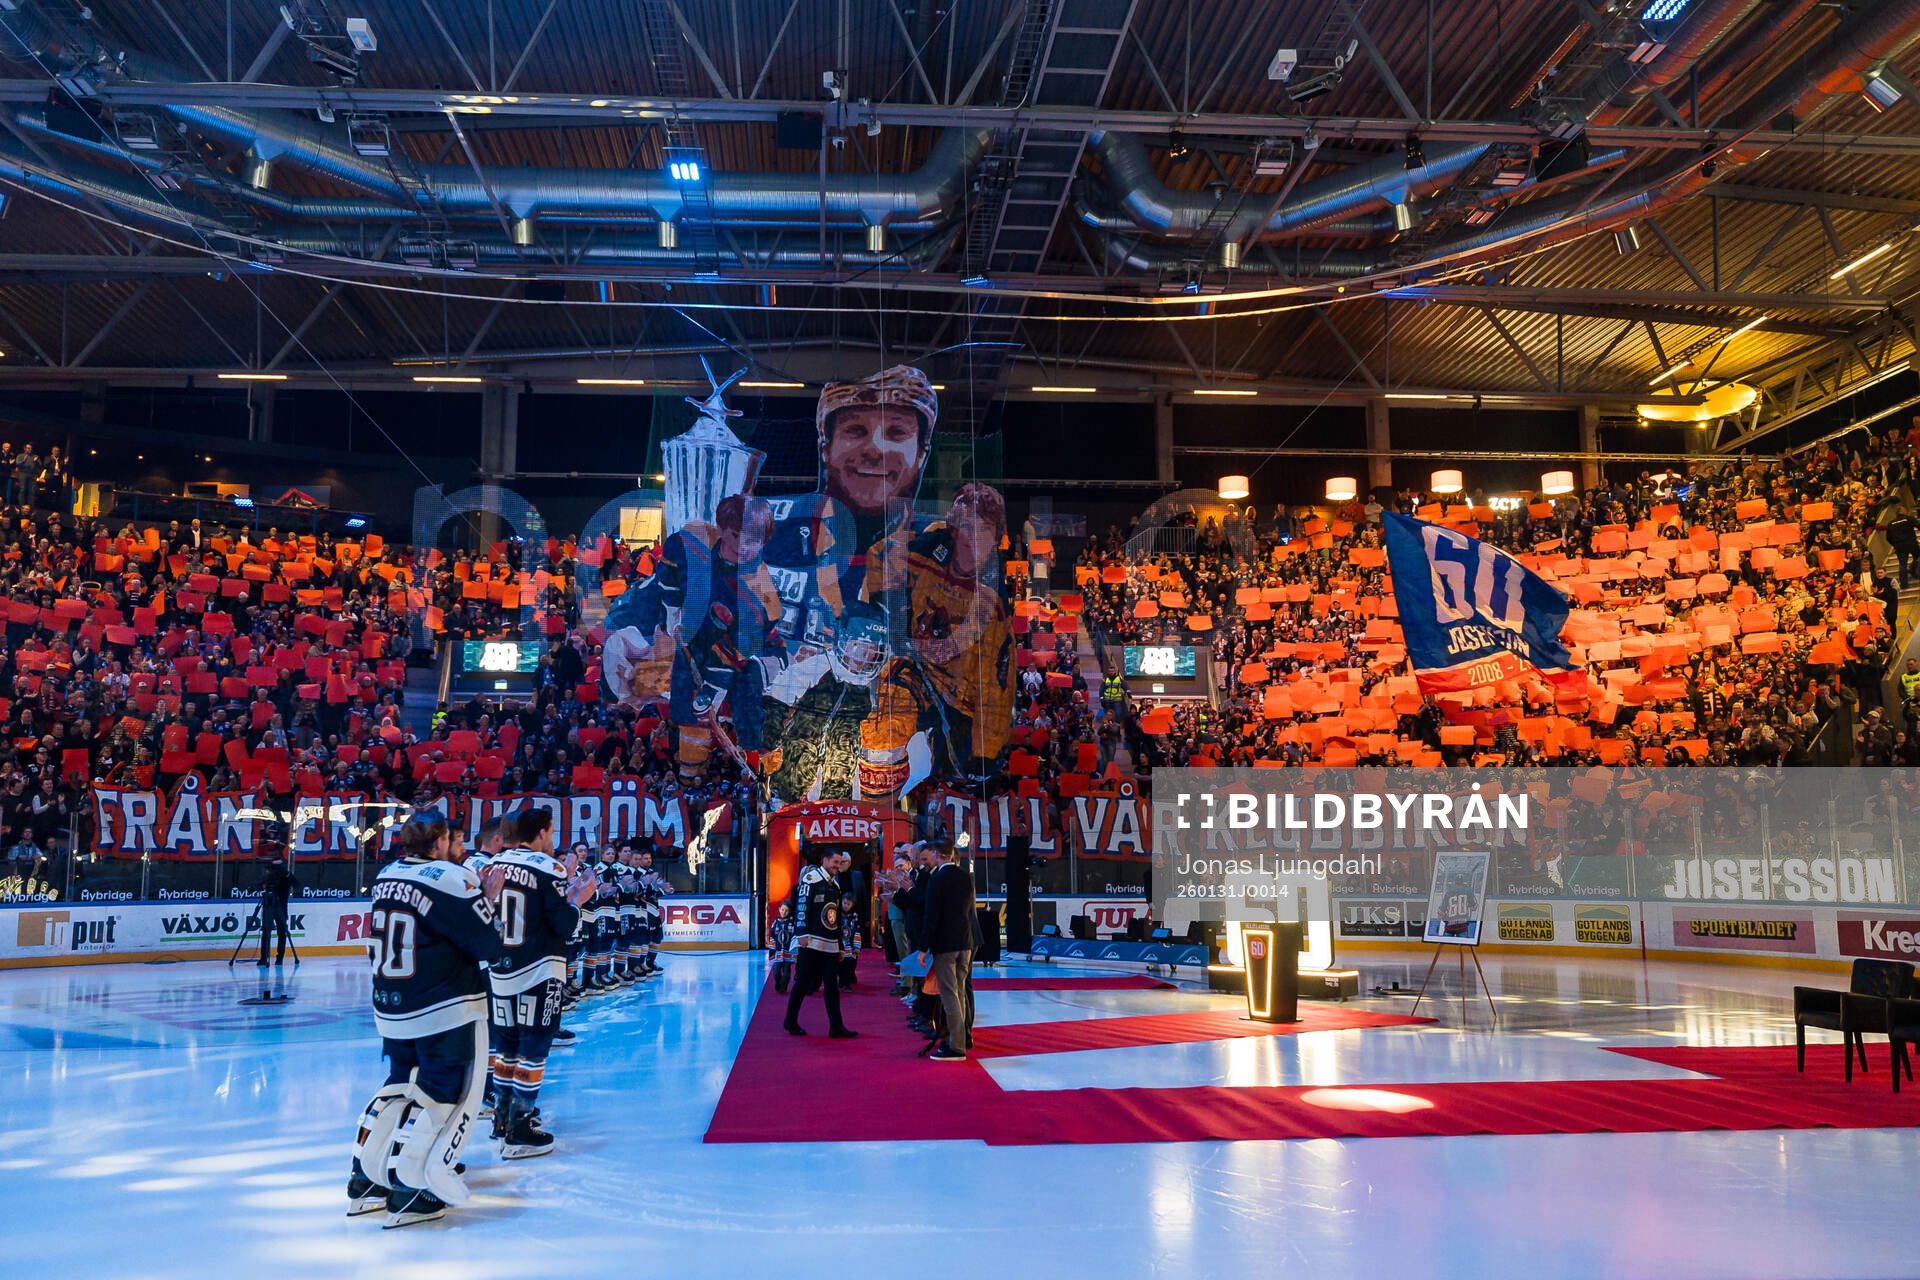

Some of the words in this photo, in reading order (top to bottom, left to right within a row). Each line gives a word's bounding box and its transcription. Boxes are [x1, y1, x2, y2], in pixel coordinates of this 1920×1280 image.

[1421, 525, 1526, 634] 60
[1468, 661, 1504, 686] 2008
[94, 775, 257, 852] FRÅN
[294, 796, 363, 851] EN
[820, 805, 859, 816] VÄXJÖ
[945, 796, 1056, 853] TILL
[1073, 780, 1182, 856] VÅR
[1664, 858, 1897, 903] JOSEFSSON
[1344, 906, 1400, 925] JKS
[1449, 894, 1468, 918] 60
[160, 912, 239, 934] VÄXJÖ
[1500, 919, 1552, 930] GOTLANDS
[1577, 920, 1630, 931] GOTLANDS
[1690, 919, 1796, 939] SPORTBLADET
[1500, 928, 1538, 940] BYGGEN
[1539, 930, 1553, 940] AB
[1578, 929, 1617, 941] BYGGEN
[1618, 931, 1630, 942] AB
[1251, 940, 1264, 956] 60
[442, 1112, 470, 1166] CCM
